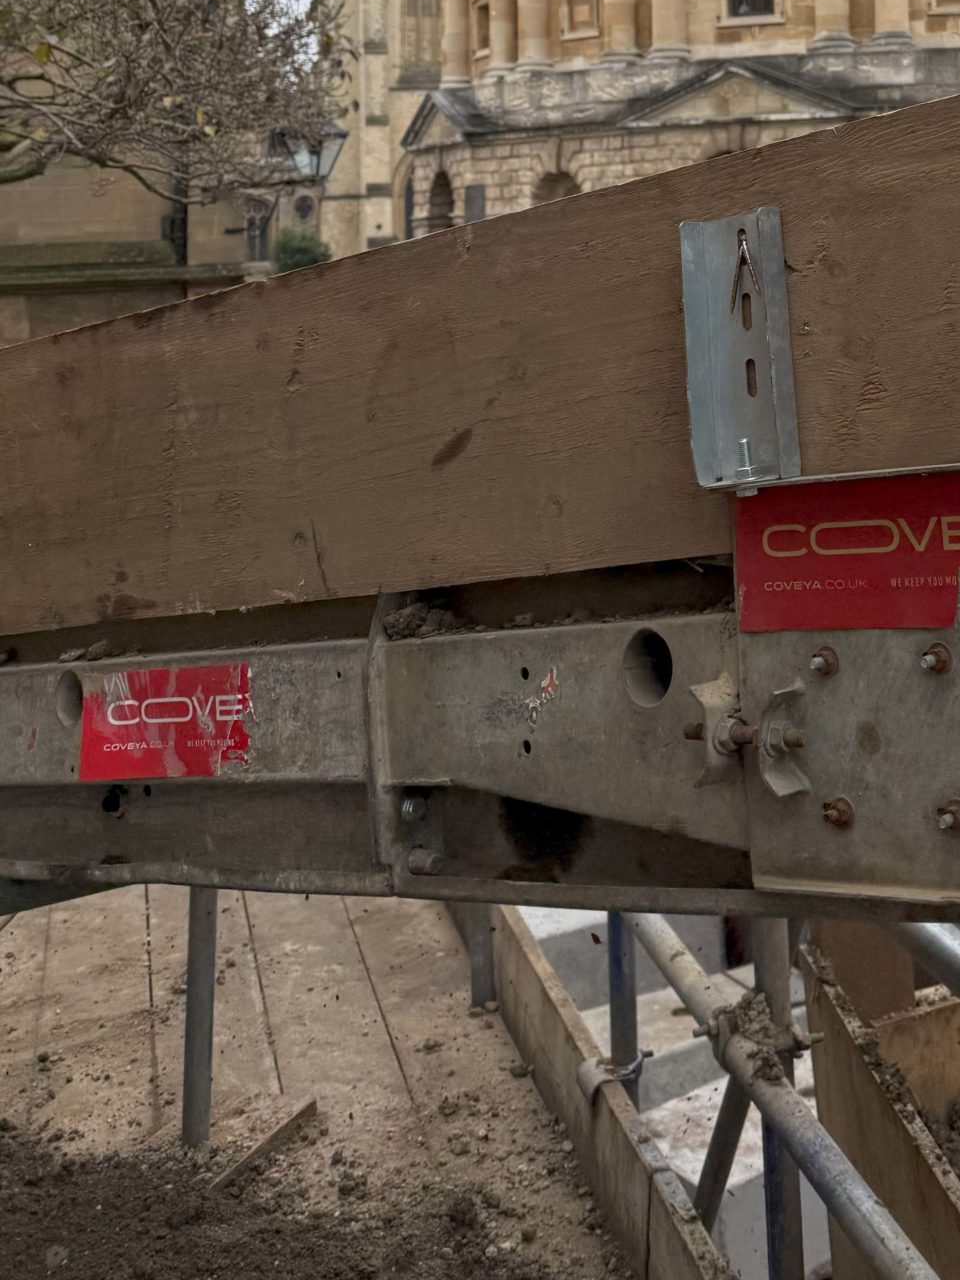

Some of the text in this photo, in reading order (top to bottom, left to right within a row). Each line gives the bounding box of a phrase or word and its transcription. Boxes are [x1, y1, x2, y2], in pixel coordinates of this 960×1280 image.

[889, 576, 902, 588] WE
[904, 575, 925, 587] KEEP
[927, 575, 943, 587] YOU
